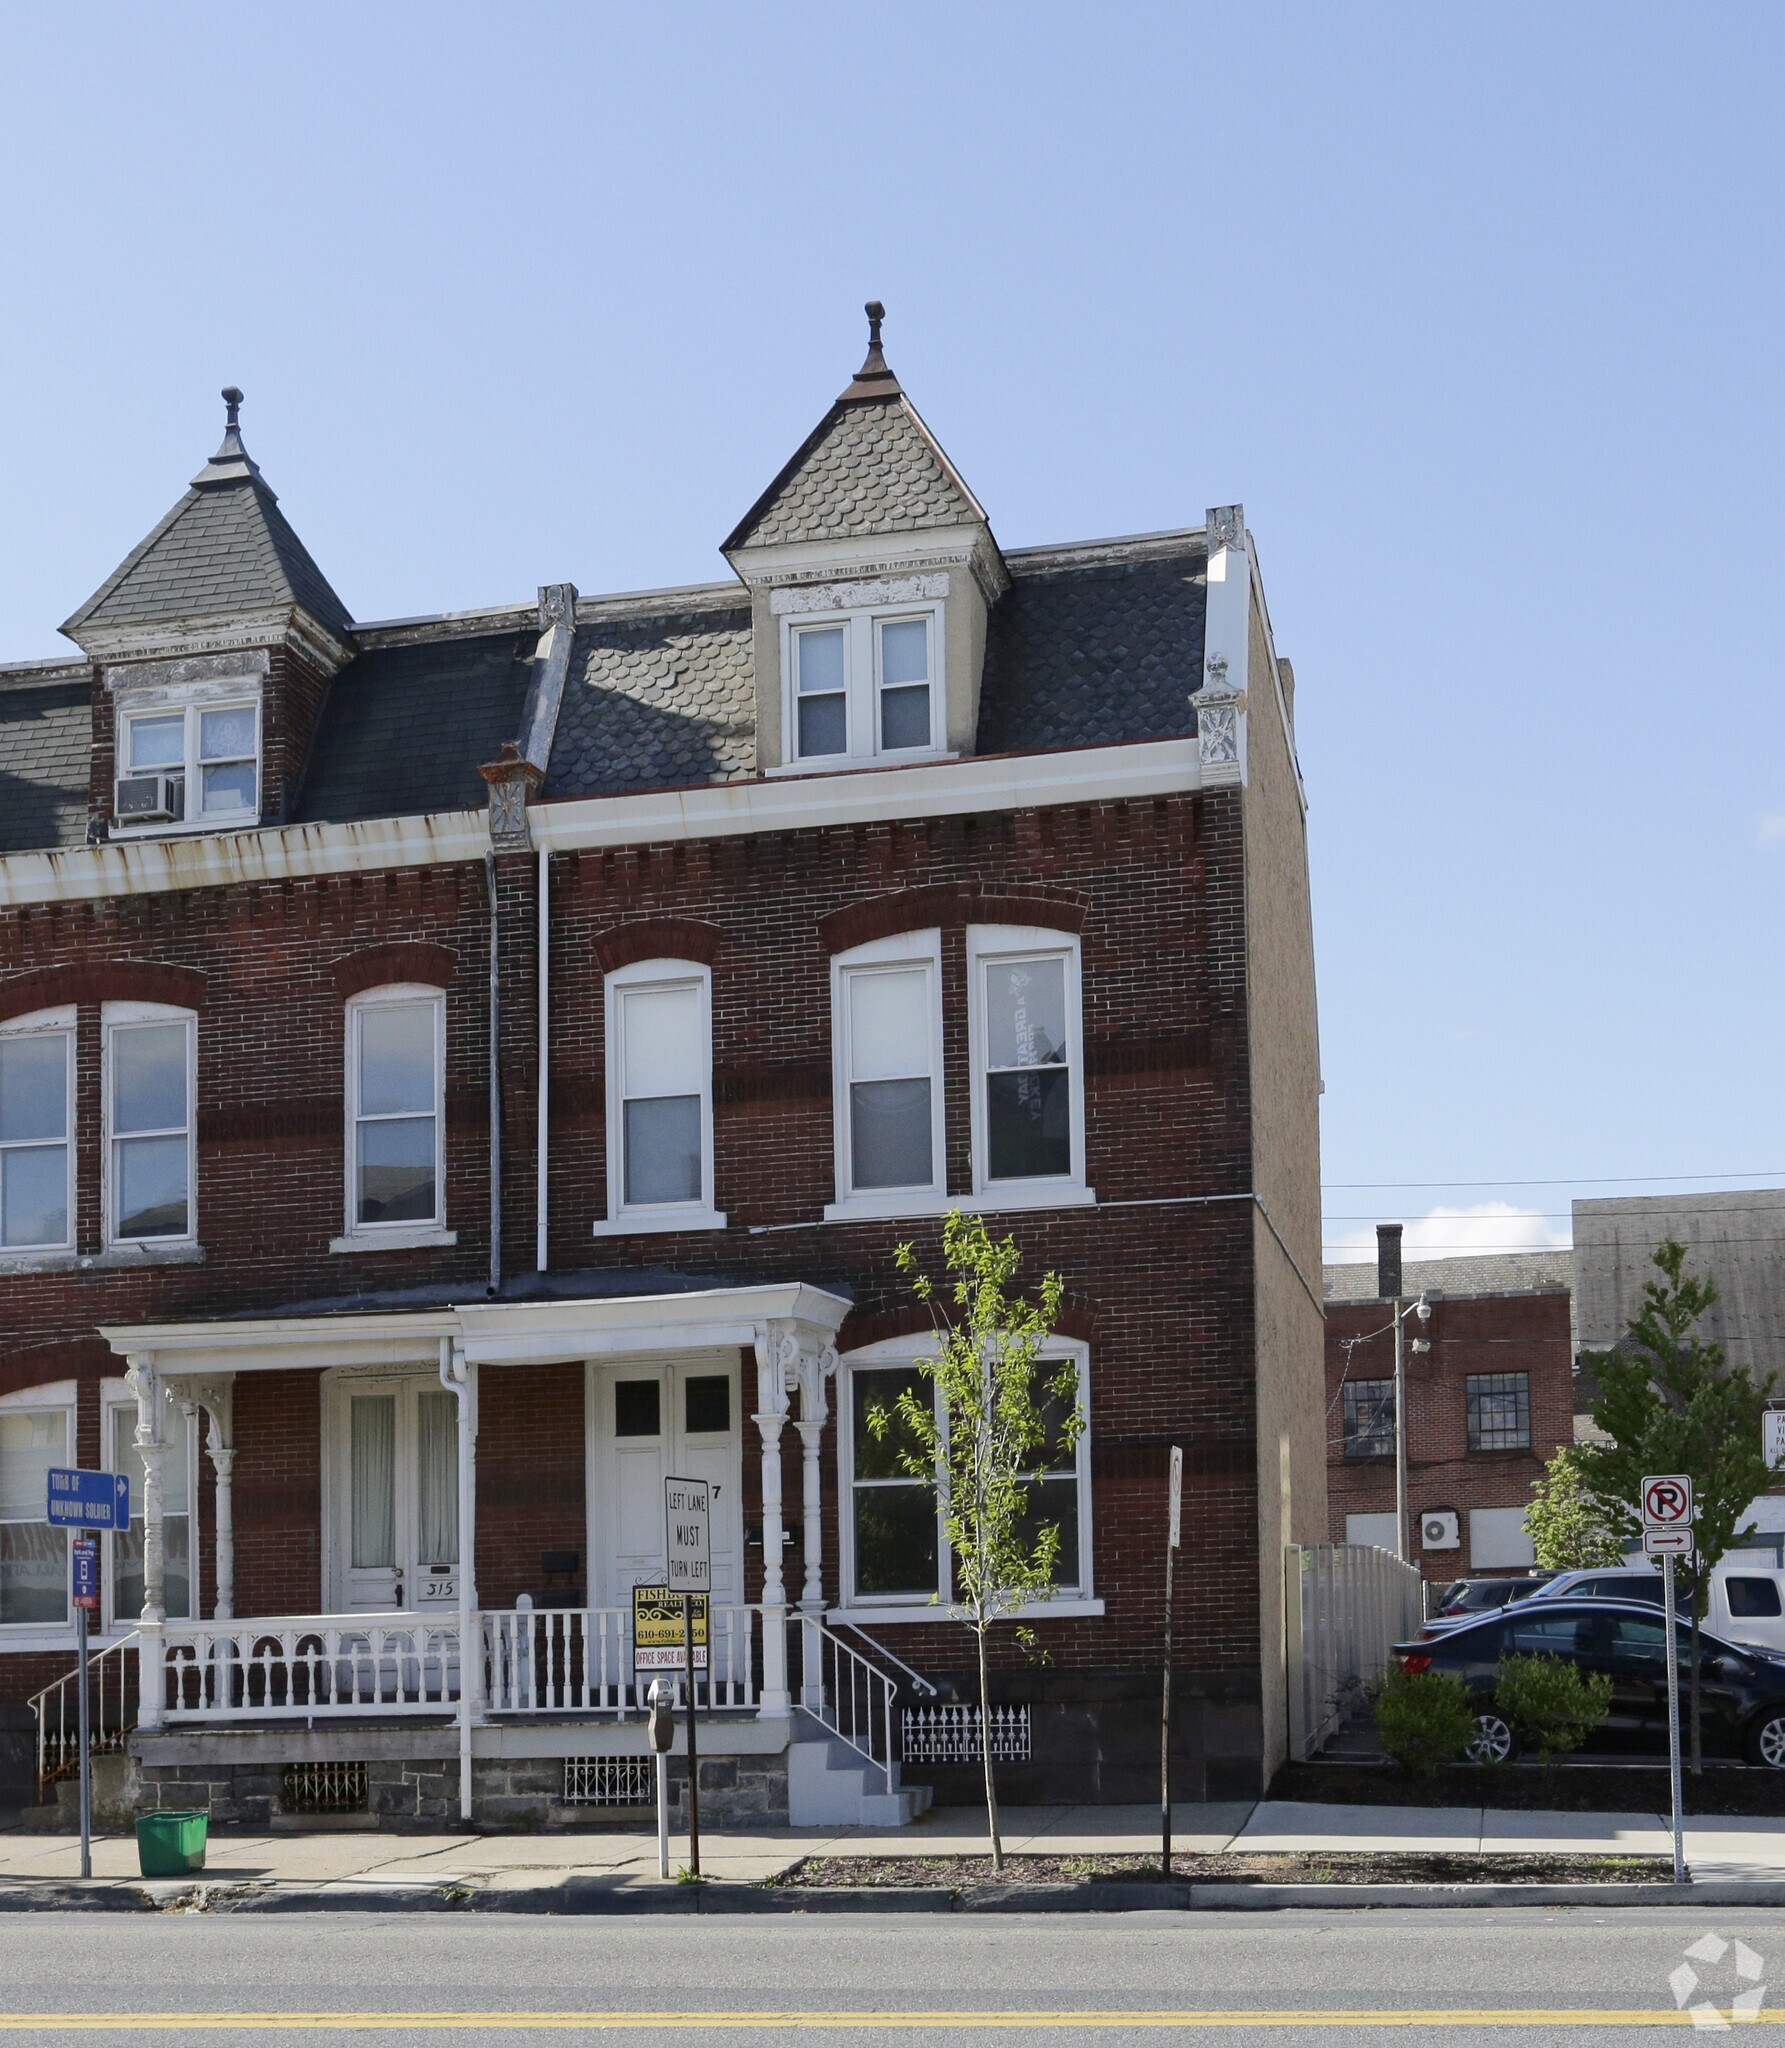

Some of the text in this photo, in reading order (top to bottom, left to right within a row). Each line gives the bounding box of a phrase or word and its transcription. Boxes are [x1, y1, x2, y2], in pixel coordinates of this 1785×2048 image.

[52, 1473, 79, 1491] TOMB OF
[712, 1486, 721, 1499] 7
[51, 1500, 111, 1520] UNKNOWN SOLDIER
[669, 1492, 706, 1512] LEFT LANE
[676, 1525, 699, 1546] MUST
[671, 1560, 708, 1578] TURN LEFT
[426, 1581, 453, 1596] 315
[637, 1628, 705, 1640] 610-691-250
[636, 1652, 655, 1665] OFFICE
[657, 1651, 675, 1664] SPACE
